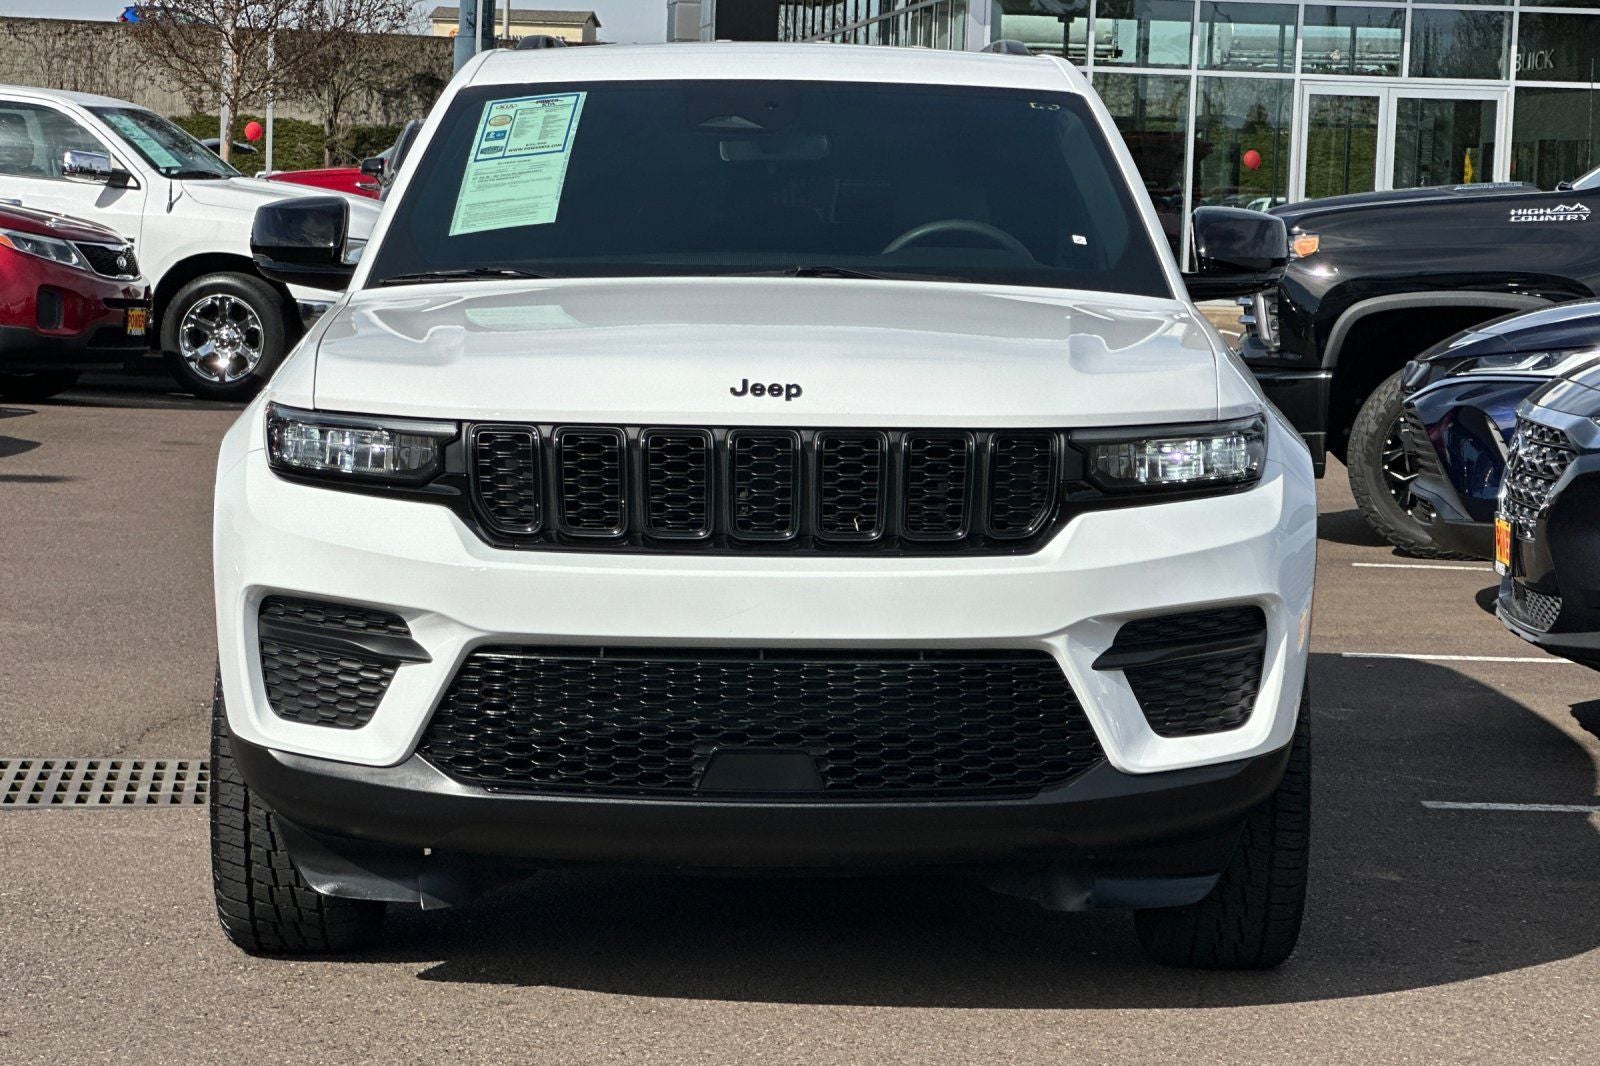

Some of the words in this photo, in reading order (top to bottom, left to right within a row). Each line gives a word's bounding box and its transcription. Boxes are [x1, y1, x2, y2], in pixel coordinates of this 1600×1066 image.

[1516, 49, 1554, 72] BUICK
[1510, 214, 1590, 222] COUNTRY
[730, 378, 803, 401] Jeep
